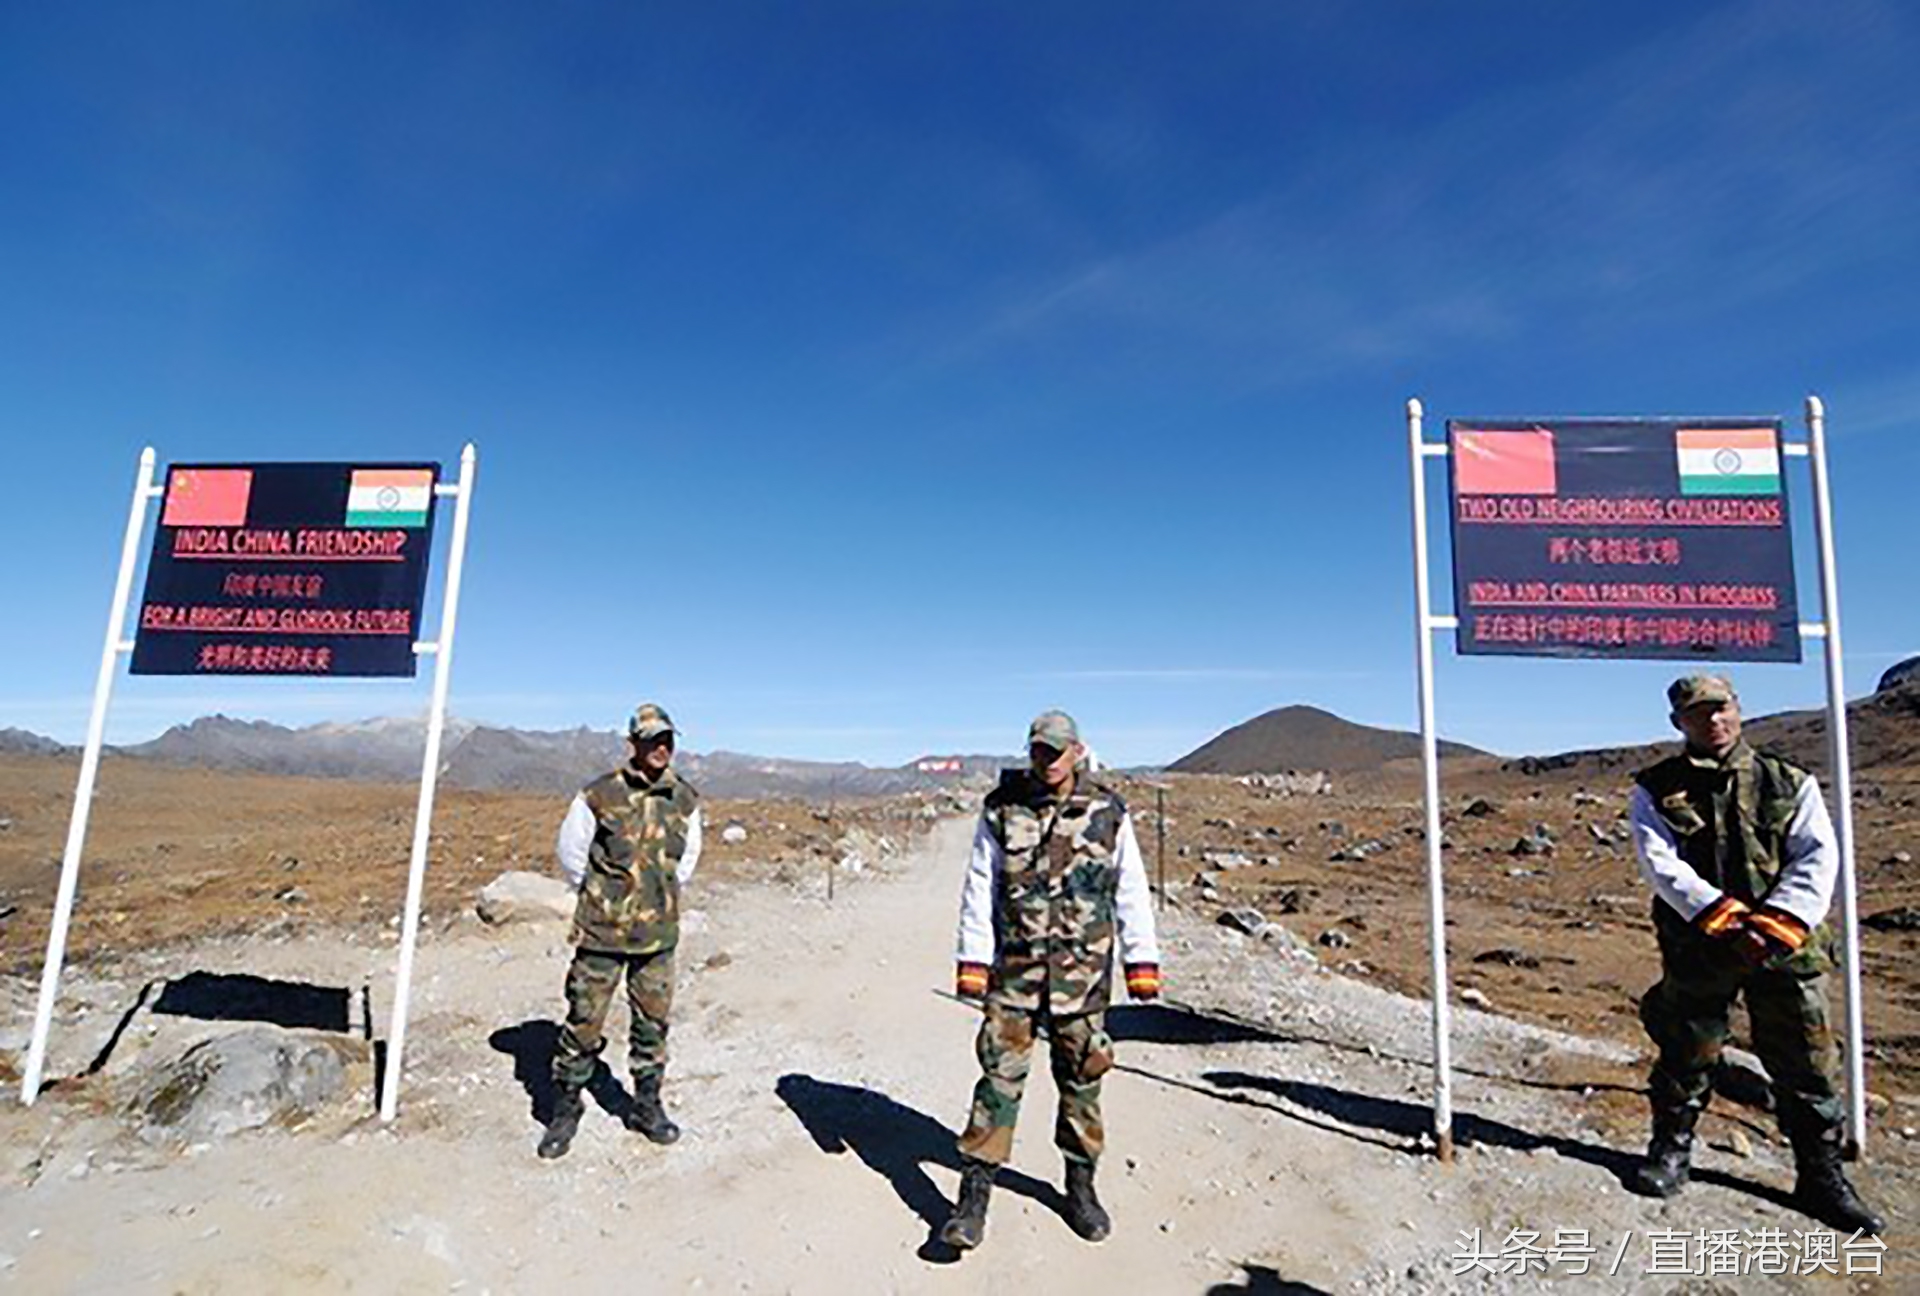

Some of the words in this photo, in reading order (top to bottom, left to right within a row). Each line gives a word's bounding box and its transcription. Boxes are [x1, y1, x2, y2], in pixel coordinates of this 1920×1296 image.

[1458, 498, 1498, 519] TWO
[1500, 498, 1535, 520] OLD
[1536, 498, 1664, 522] NEIGHBOURING
[1666, 499, 1780, 522] CIVILIZATIONS
[174, 528, 228, 552] INDIA
[232, 529, 291, 553] CHINA
[295, 529, 408, 556] FRIENDSHIP
[1468, 582, 1511, 602] INDIA
[1514, 583, 1549, 603] AND
[1550, 583, 1598, 604] CHINA
[1600, 584, 1677, 605] PARTNERS
[1678, 585, 1698, 605] IN
[142, 604, 174, 627] FOR
[176, 606, 187, 627] A
[188, 606, 243, 629] BRIGHT
[243, 607, 277, 631] AND
[279, 608, 353, 631] GLORIOUS
[354, 609, 410, 633] FUTURE
